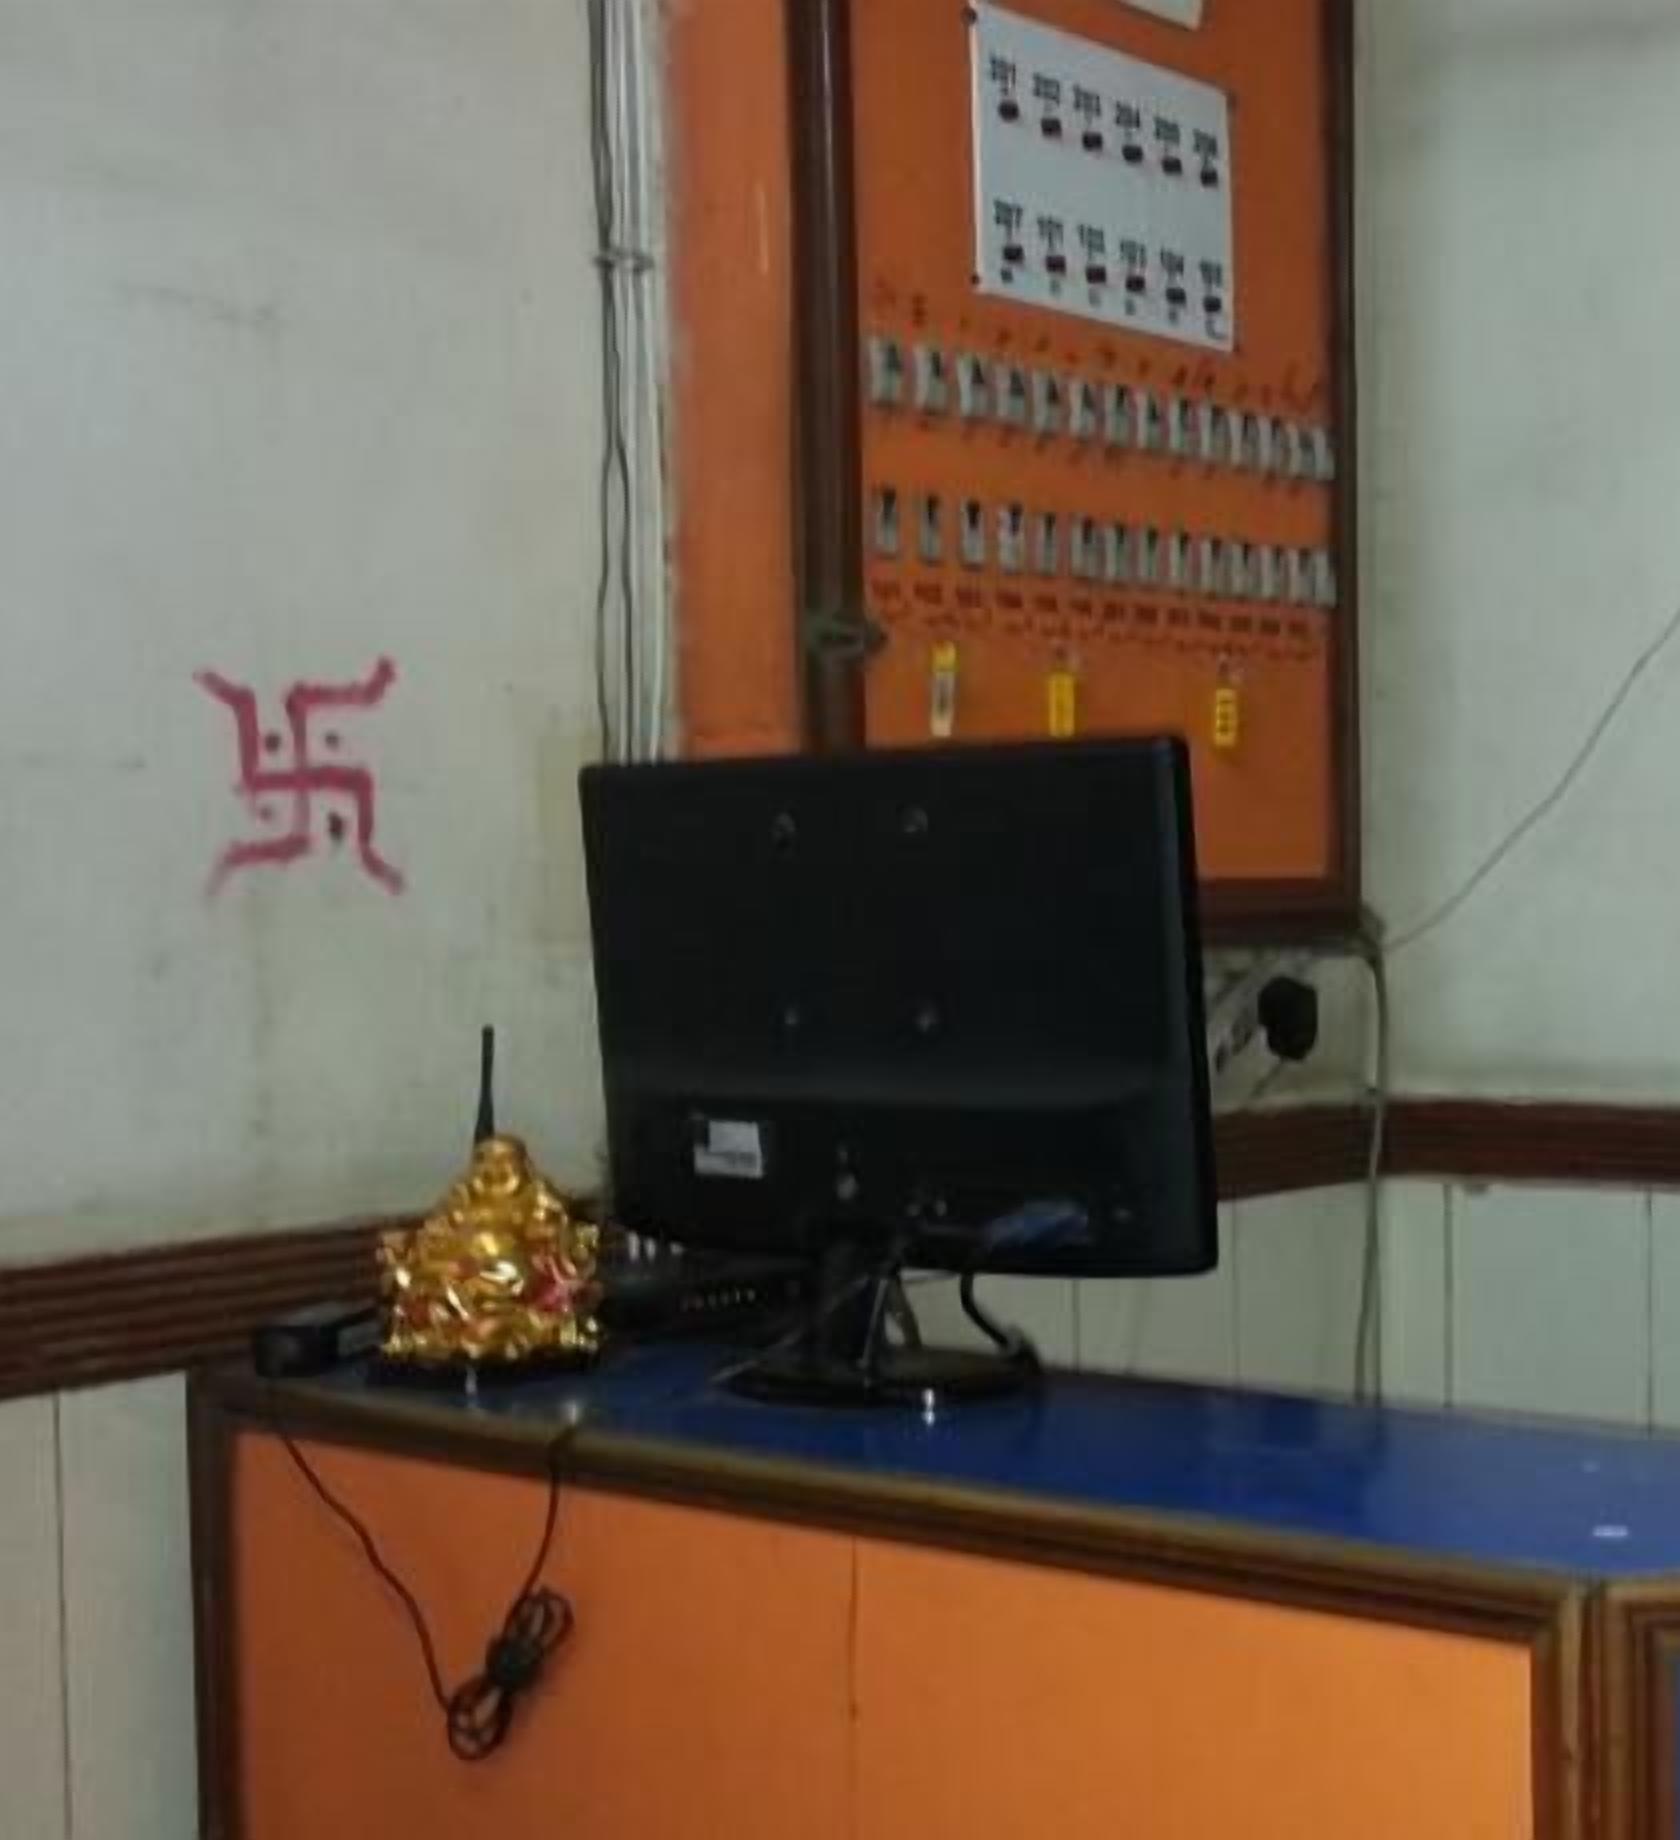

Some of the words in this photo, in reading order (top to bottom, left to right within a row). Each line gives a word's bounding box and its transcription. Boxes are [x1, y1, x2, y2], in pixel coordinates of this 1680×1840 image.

[989, 54, 1017, 87] 201
[1032, 72, 1061, 104] 202
[1115, 101, 1141, 129] 204
[993, 199, 1024, 230] 207
